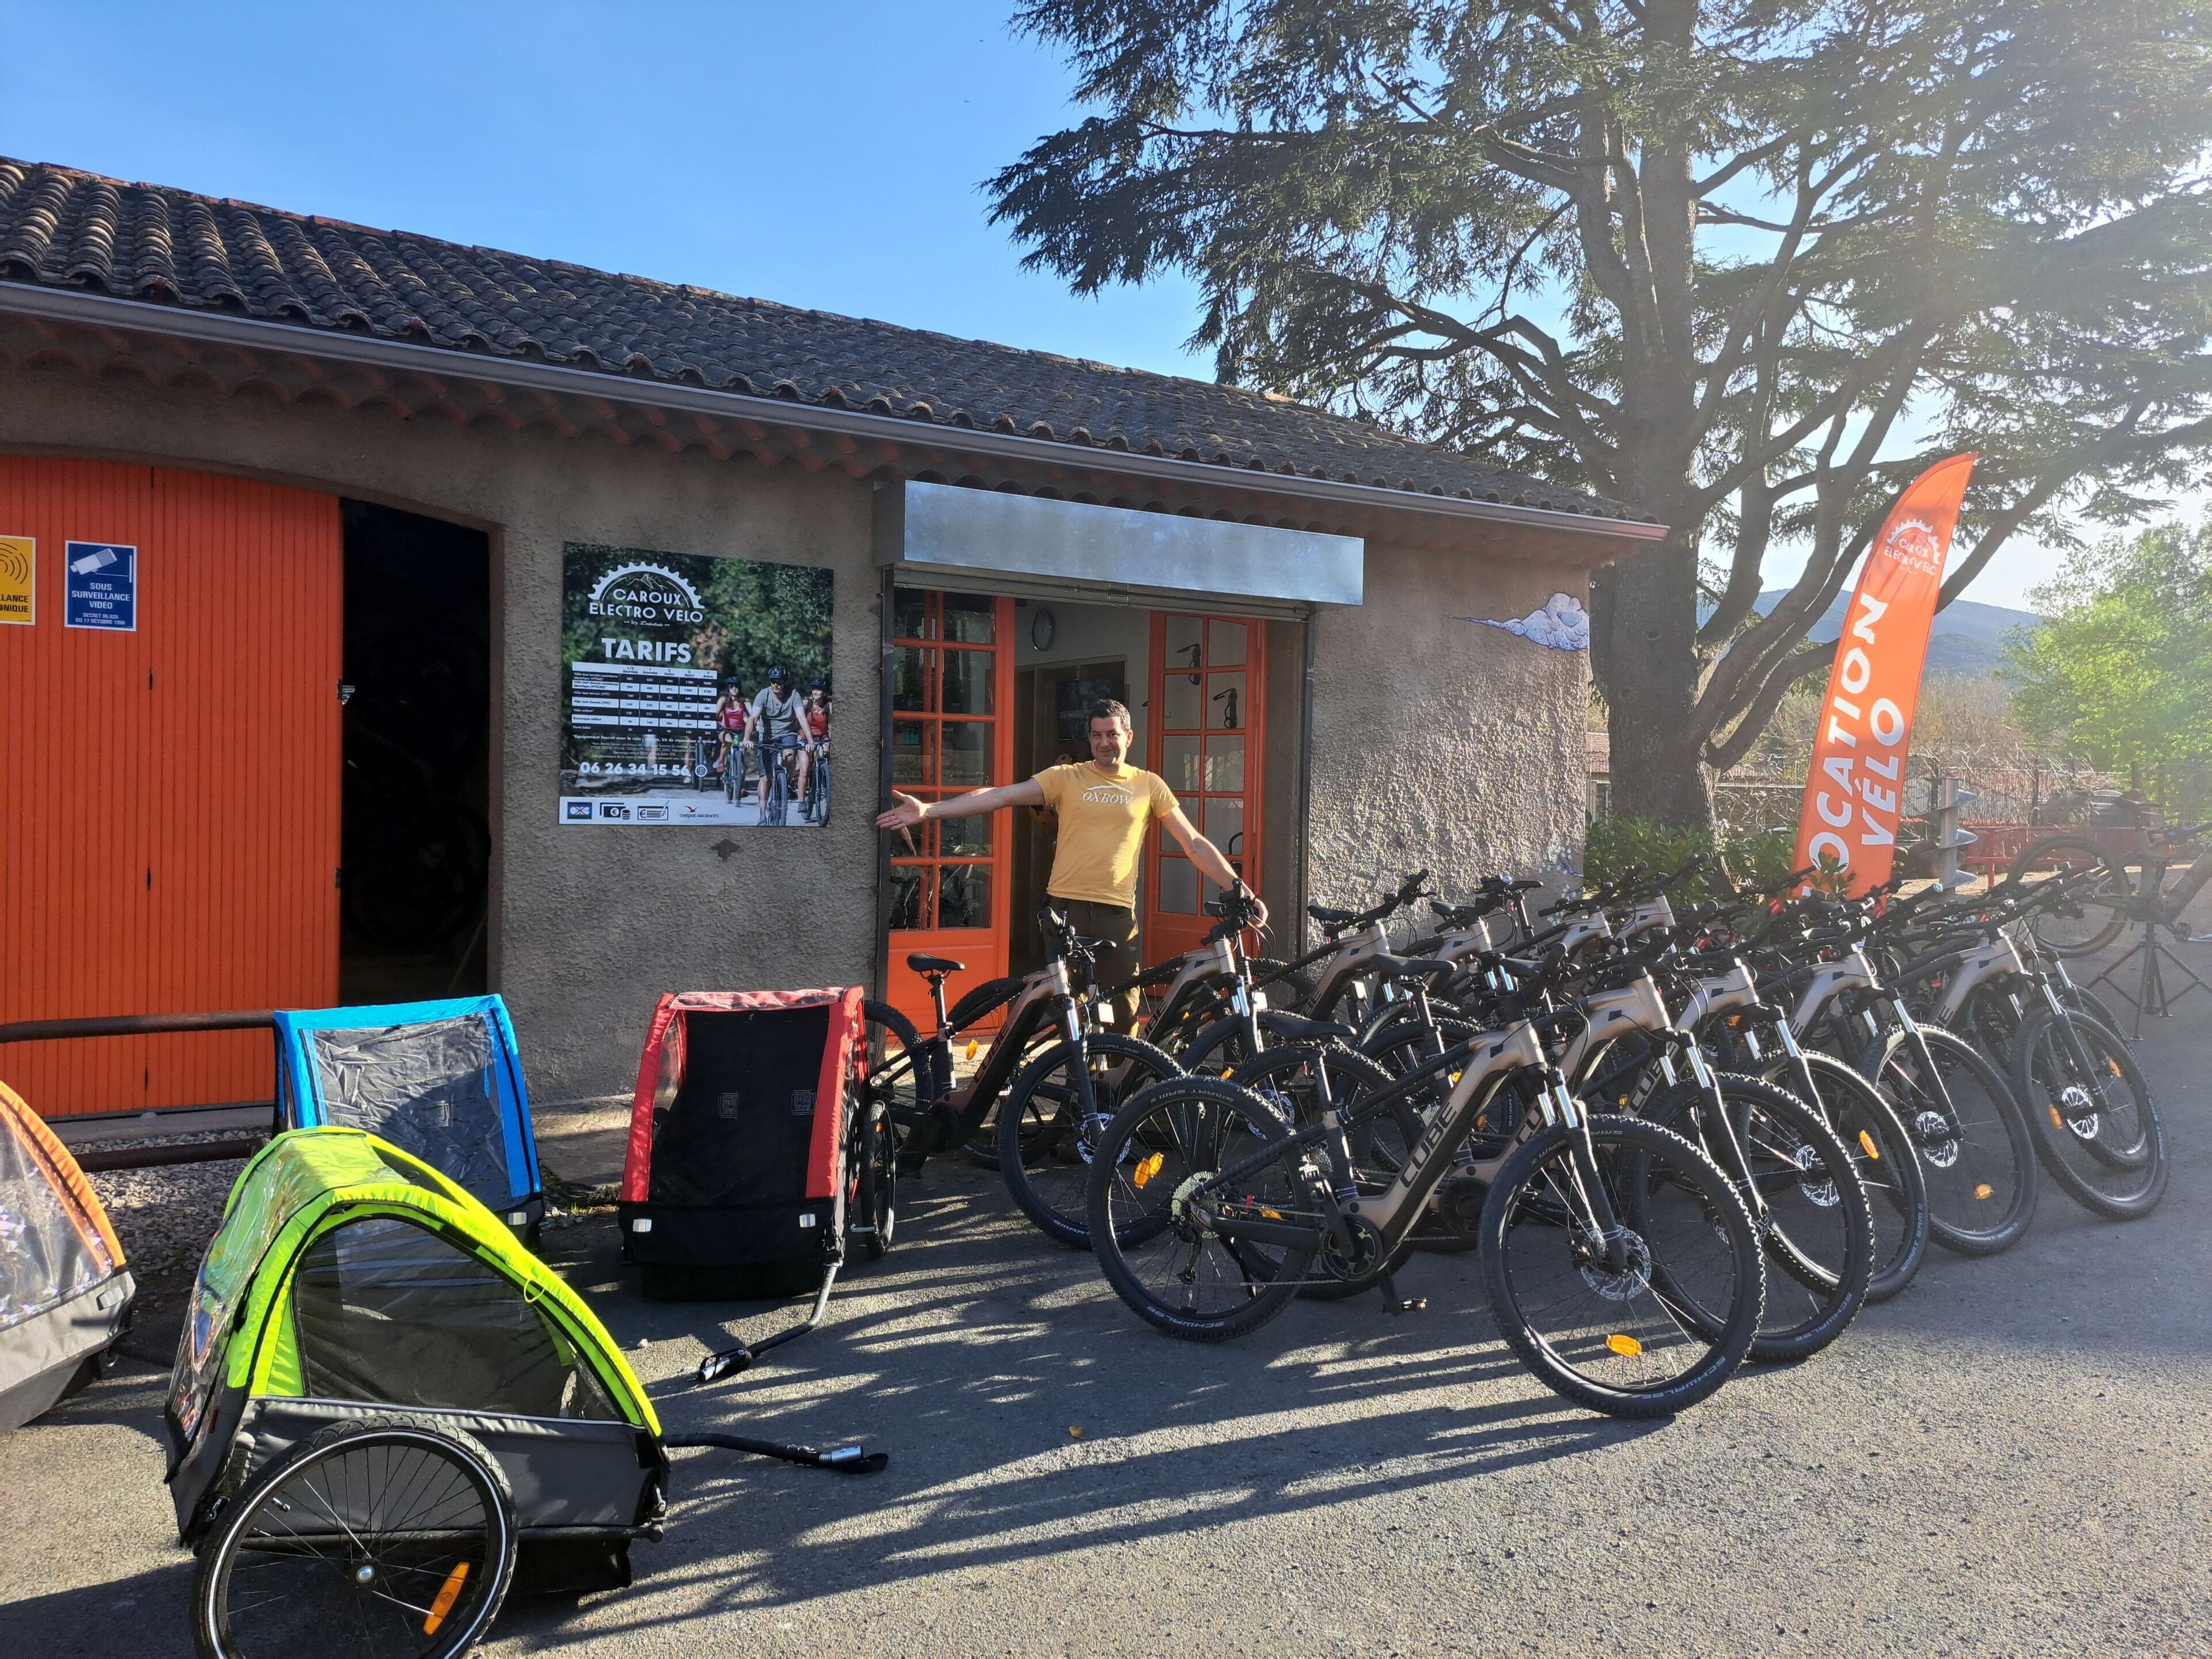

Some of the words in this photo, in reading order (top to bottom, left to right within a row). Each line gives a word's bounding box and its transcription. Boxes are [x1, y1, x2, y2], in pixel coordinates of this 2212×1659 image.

[71, 590, 130, 601] SURVEILLANCE
[90, 582, 112, 590] SOUS
[613, 589, 681, 605] CAROUX
[0, 594, 29, 603] LANCE
[89, 601, 112, 609] VIDEO
[589, 603, 656, 619] ELECTRO
[664, 608, 703, 622] VELO
[601, 638, 691, 663] TARIFS
[1802, 592, 1888, 906] OCATION
[580, 762, 600, 774] 06
[605, 762, 623, 774] 26
[627, 763, 646, 775] 34
[652, 764, 667, 775] 15
[672, 764, 690, 777] 56
[1854, 698, 1904, 846] VÉLO
[1083, 791, 1134, 805] OXBOW
[974, 1021, 1010, 1084] CUBE
[1400, 1101, 1457, 1188] CUBE
[1900, 1240, 1919, 1272] SMART
[1146, 1305, 1225, 1328] SCHWALBE
[1794, 1291, 1852, 1342] SCHWALBE
[1642, 1355, 1726, 1399] SCHWALBE
